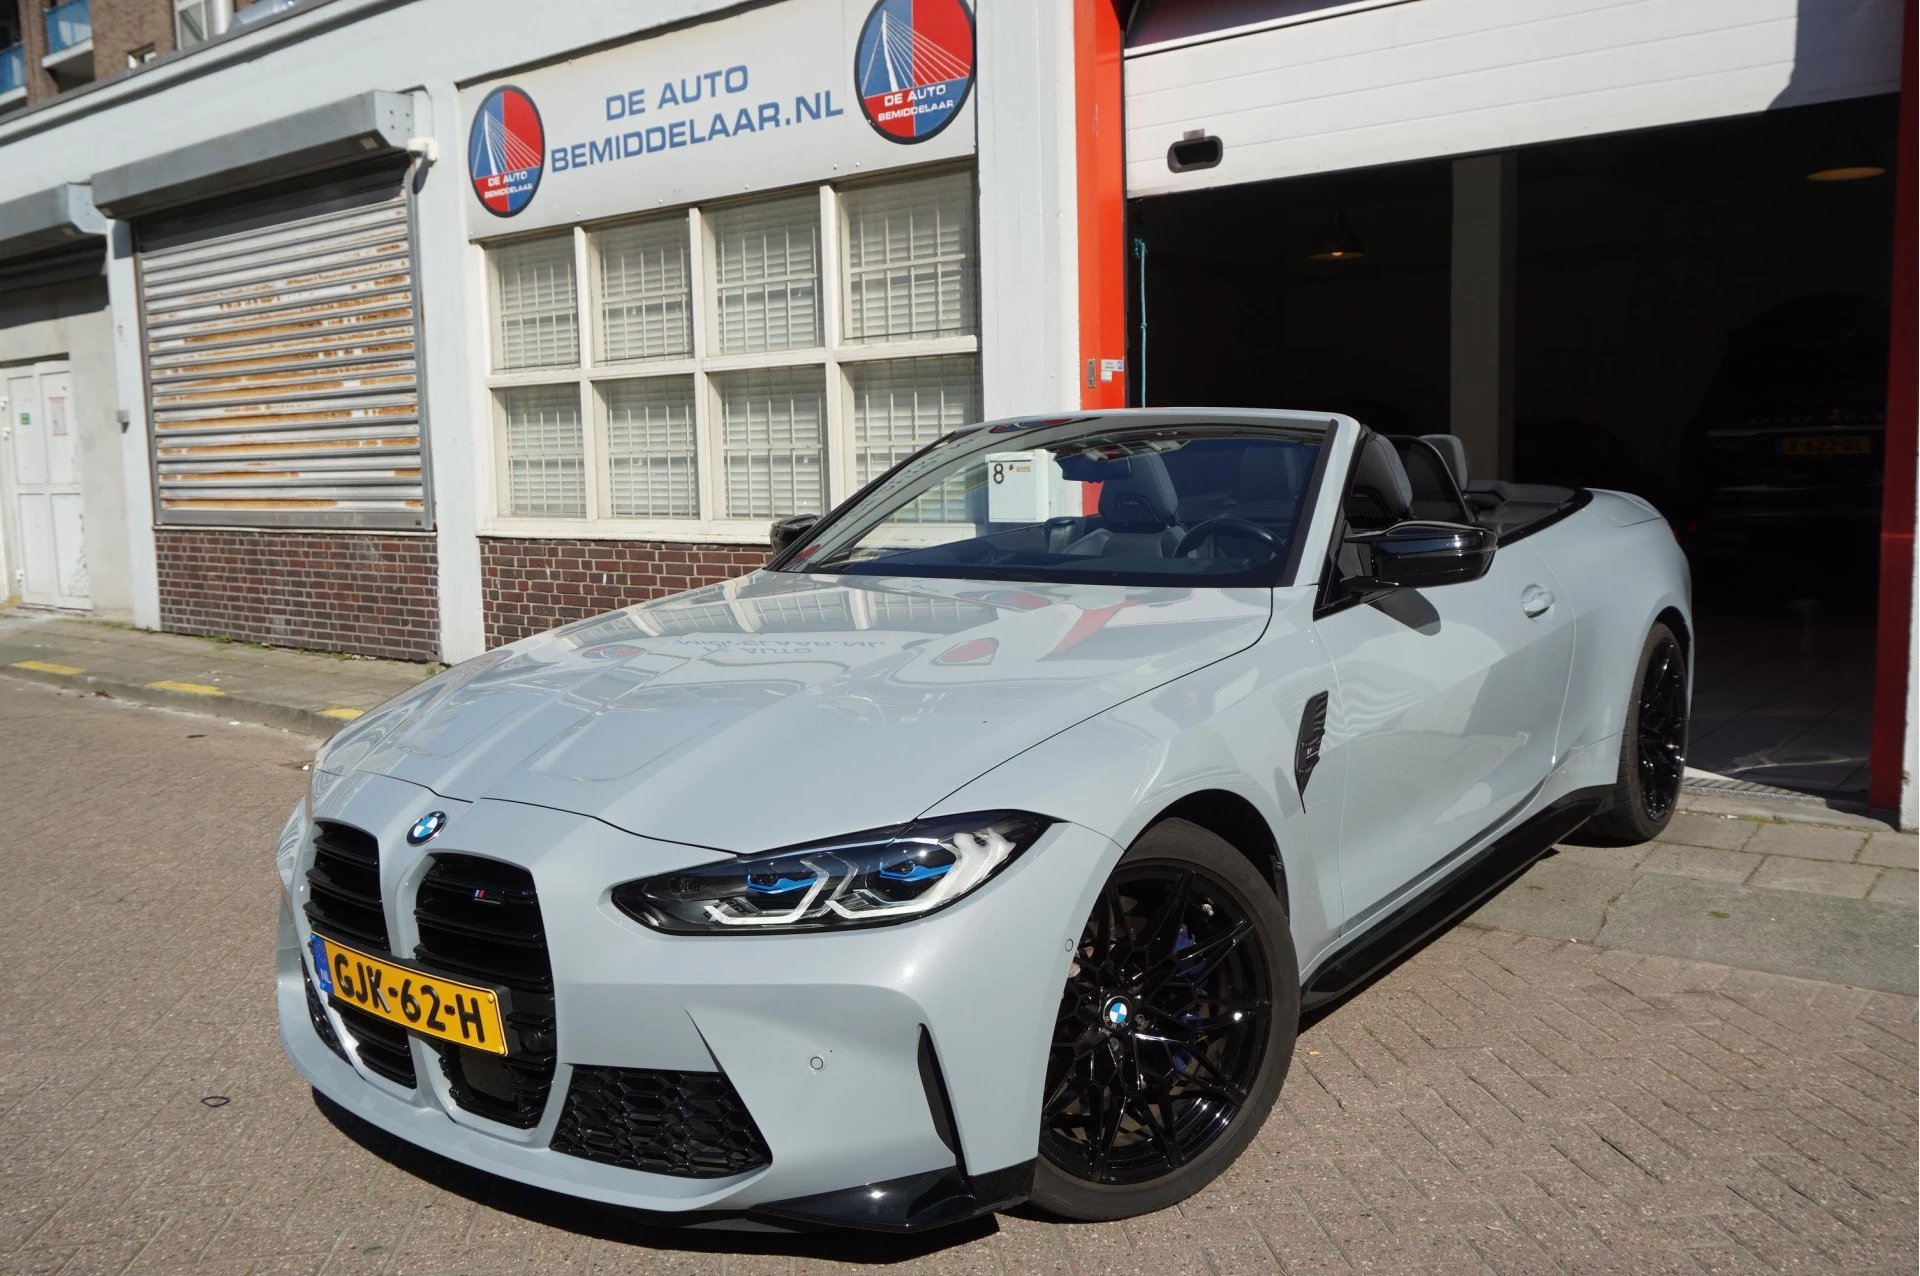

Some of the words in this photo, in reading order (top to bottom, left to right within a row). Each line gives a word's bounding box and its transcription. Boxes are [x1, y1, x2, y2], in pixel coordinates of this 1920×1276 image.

[606, 88, 645, 121] DE
[657, 64, 748, 110] AUTO
[884, 93, 903, 107] DE
[907, 84, 946, 102] AUTO
[878, 100, 954, 122] BEMIDDELAAR
[551, 90, 844, 173] BEMIDDELAAR.NL
[487, 176, 501, 187] DE
[503, 170, 528, 184] AUTO
[484, 183, 533, 199] BEMIDDELAAR
[993, 462, 1005, 484] 8
[320, 968, 332, 985] NL
[334, 952, 486, 1044] GJK-62-H
